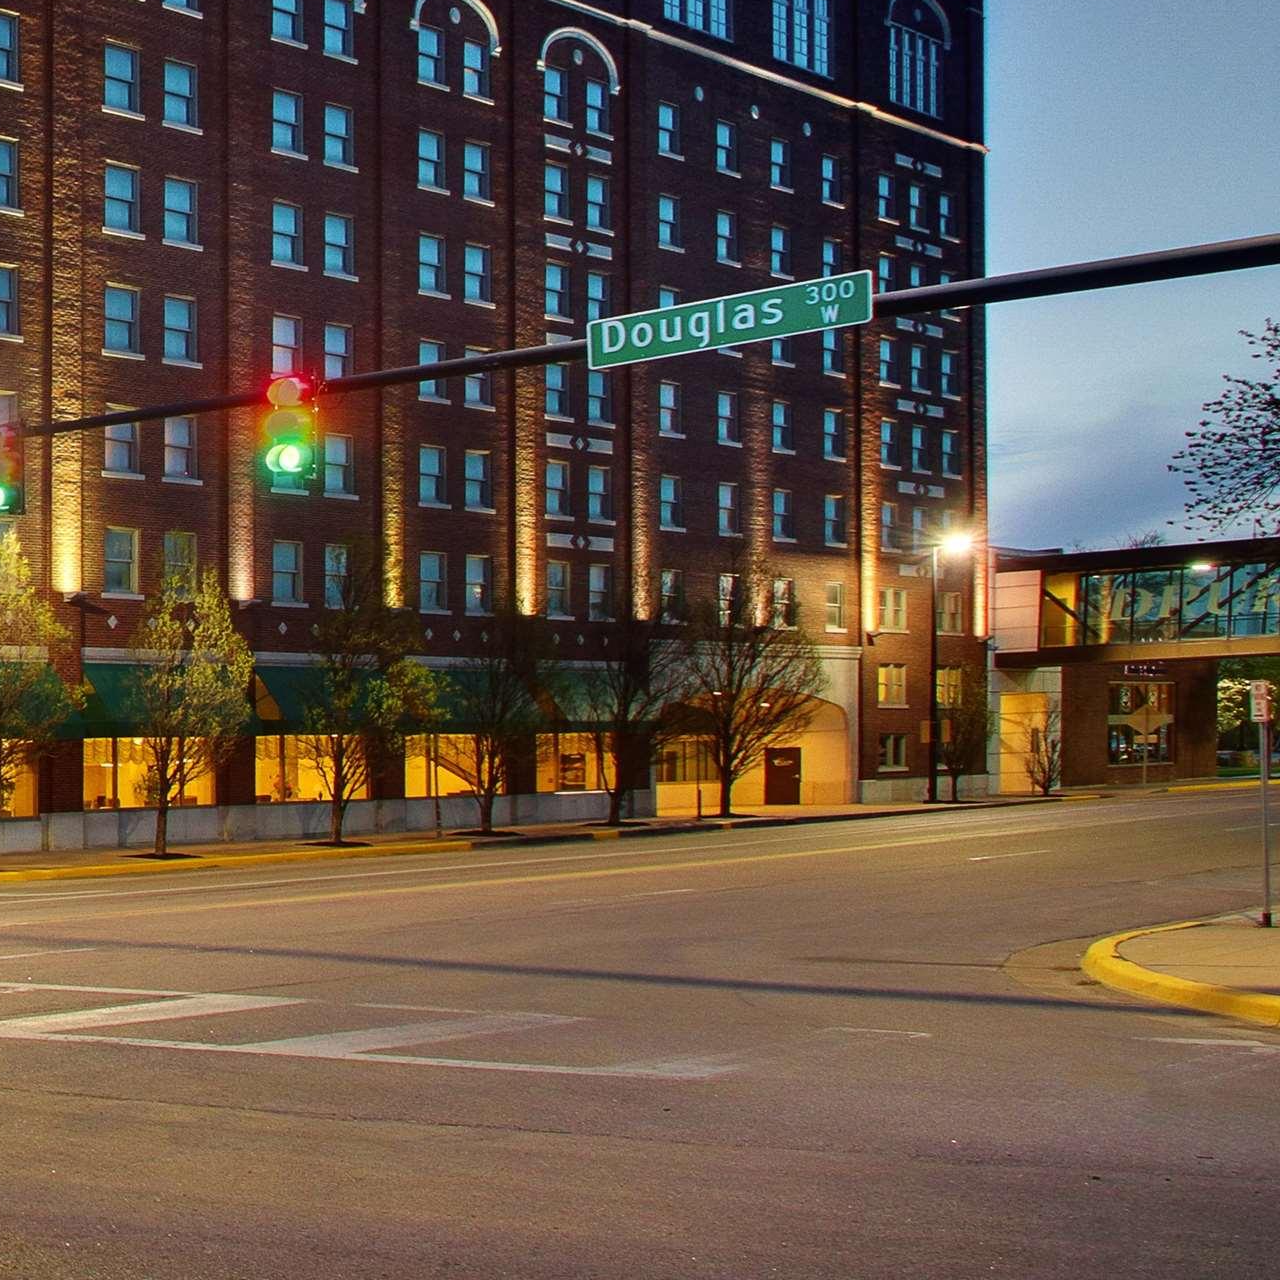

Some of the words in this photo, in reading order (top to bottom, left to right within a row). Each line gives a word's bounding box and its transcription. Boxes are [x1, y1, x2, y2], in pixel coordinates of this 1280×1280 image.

[806, 280, 854, 304] 300
[602, 298, 783, 354] Douglas
[820, 305, 839, 324] W
